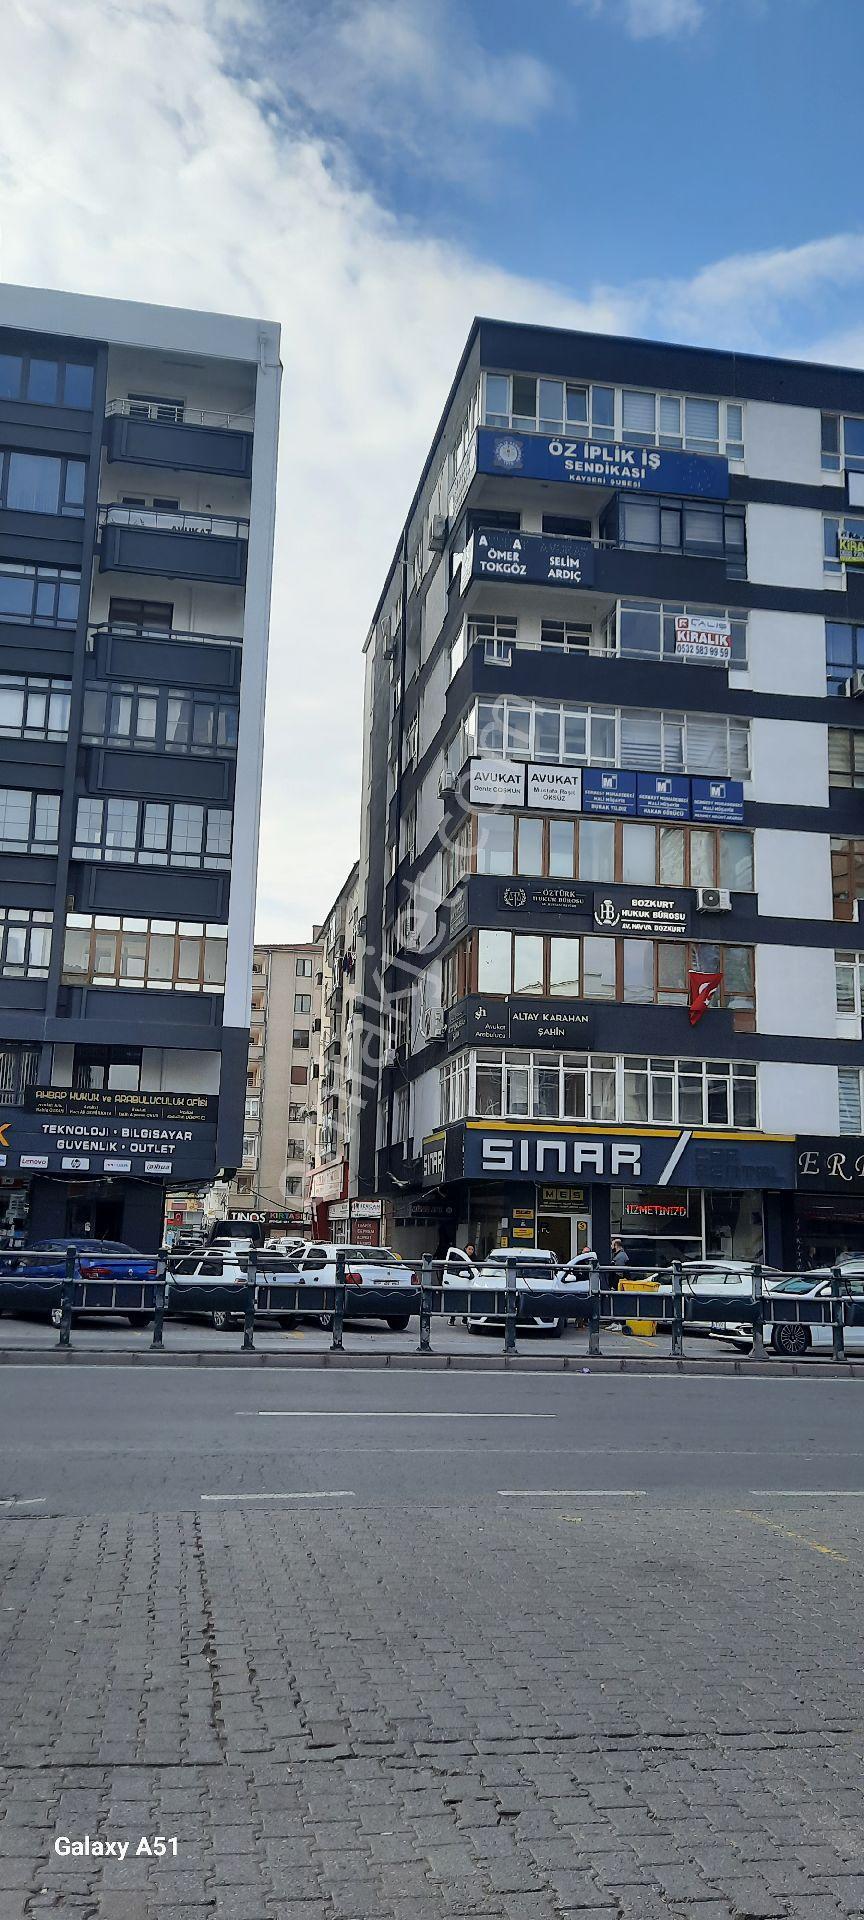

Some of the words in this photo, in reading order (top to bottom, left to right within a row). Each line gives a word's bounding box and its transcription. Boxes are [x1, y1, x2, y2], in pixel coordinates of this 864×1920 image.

[548, 439, 577, 457] ÖZ
[584, 442, 635, 464] İPLİK
[642, 448, 661, 469] İŞ
[564, 460, 646, 478] SENDİKASI
[488, 548, 519, 562] ÖMER
[480, 561, 527, 575] TOKGÖZ
[550, 556, 580, 568] SELİM
[548, 569, 581, 582] ARDIÇ
[696, 645, 708, 655] 583
[474, 772, 521, 784] AVUKAT
[531, 773, 578, 785] AVUKAT
[542, 889, 575, 898] ÖZTÜRK
[632, 899, 674, 908] BOZKURT
[622, 910, 650, 918] HUKUK
[653, 910, 685, 920] BÜROSU
[543, 1014, 589, 1022] KARAHAN
[538, 1027, 565, 1036] ŞAHİN
[70, 1093, 100, 1102] HUKUK
[115, 1095, 185, 1106] ARABULUCULUK
[130, 1143, 176, 1154] OUTLET
[482, 1138, 640, 1176] SINAR
